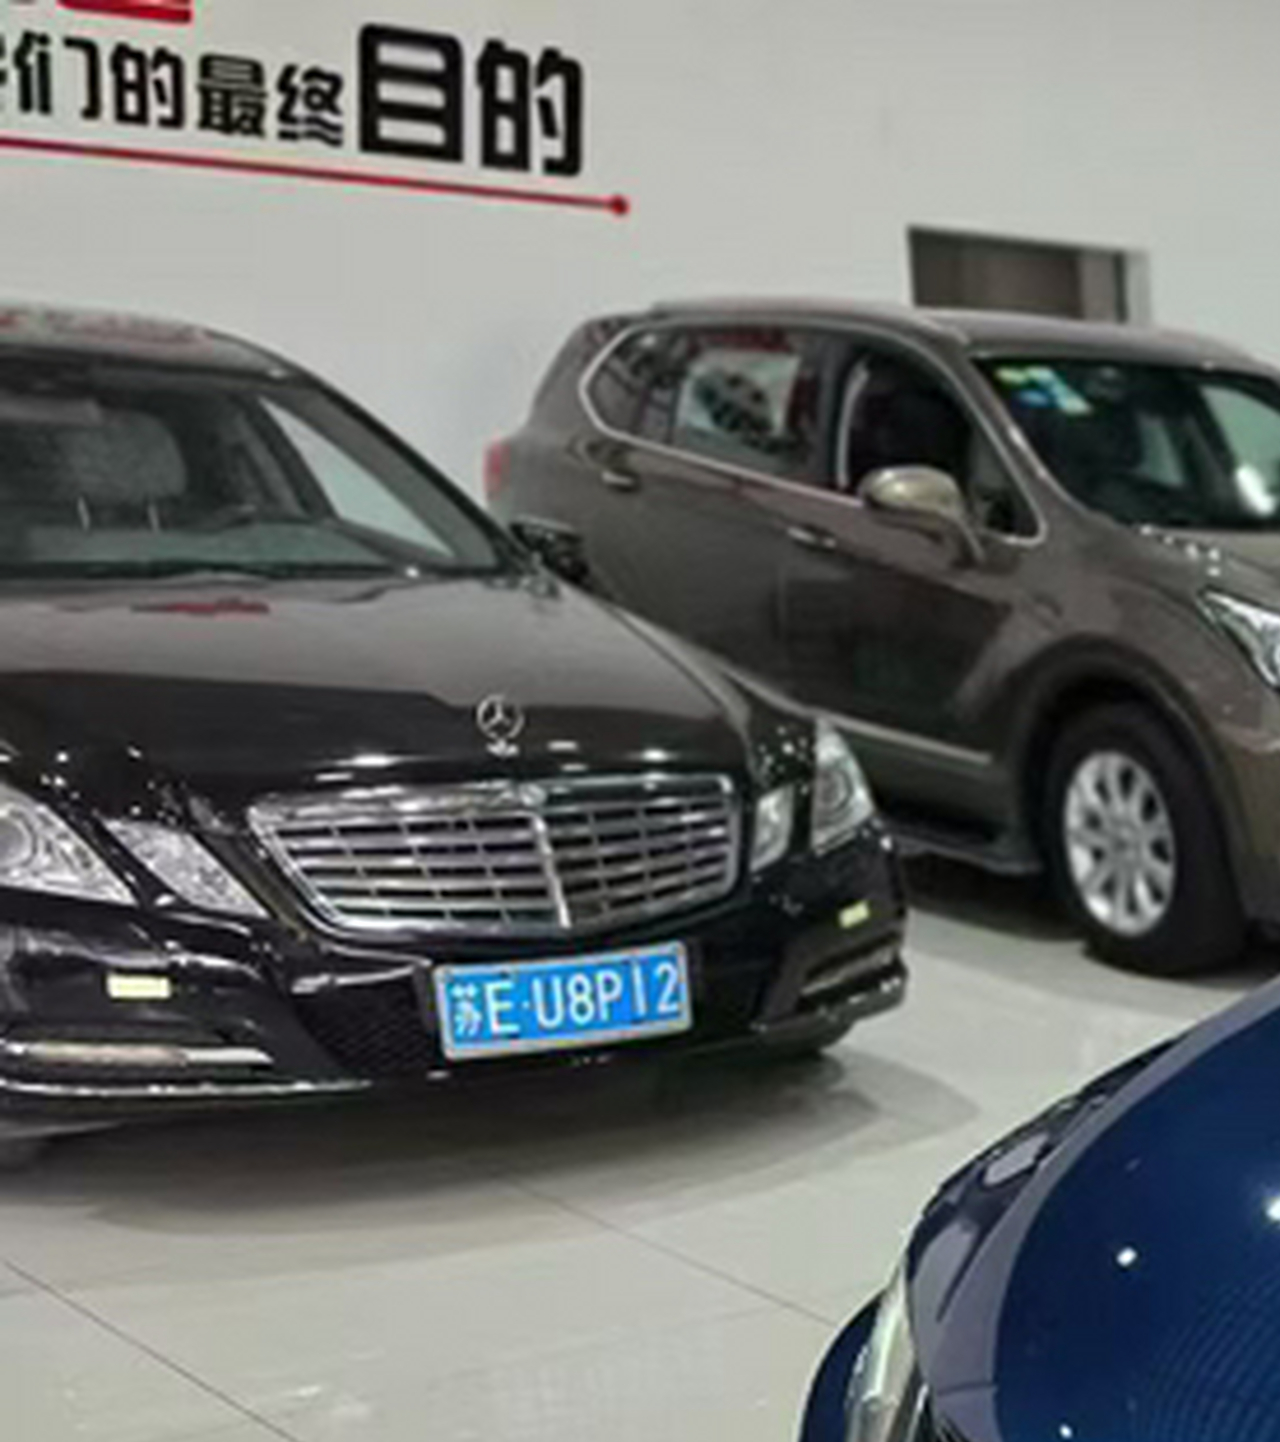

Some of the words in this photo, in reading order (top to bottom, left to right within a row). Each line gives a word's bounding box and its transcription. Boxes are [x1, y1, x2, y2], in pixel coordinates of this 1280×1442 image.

[0, 24, 583, 177] 们的最终目的
